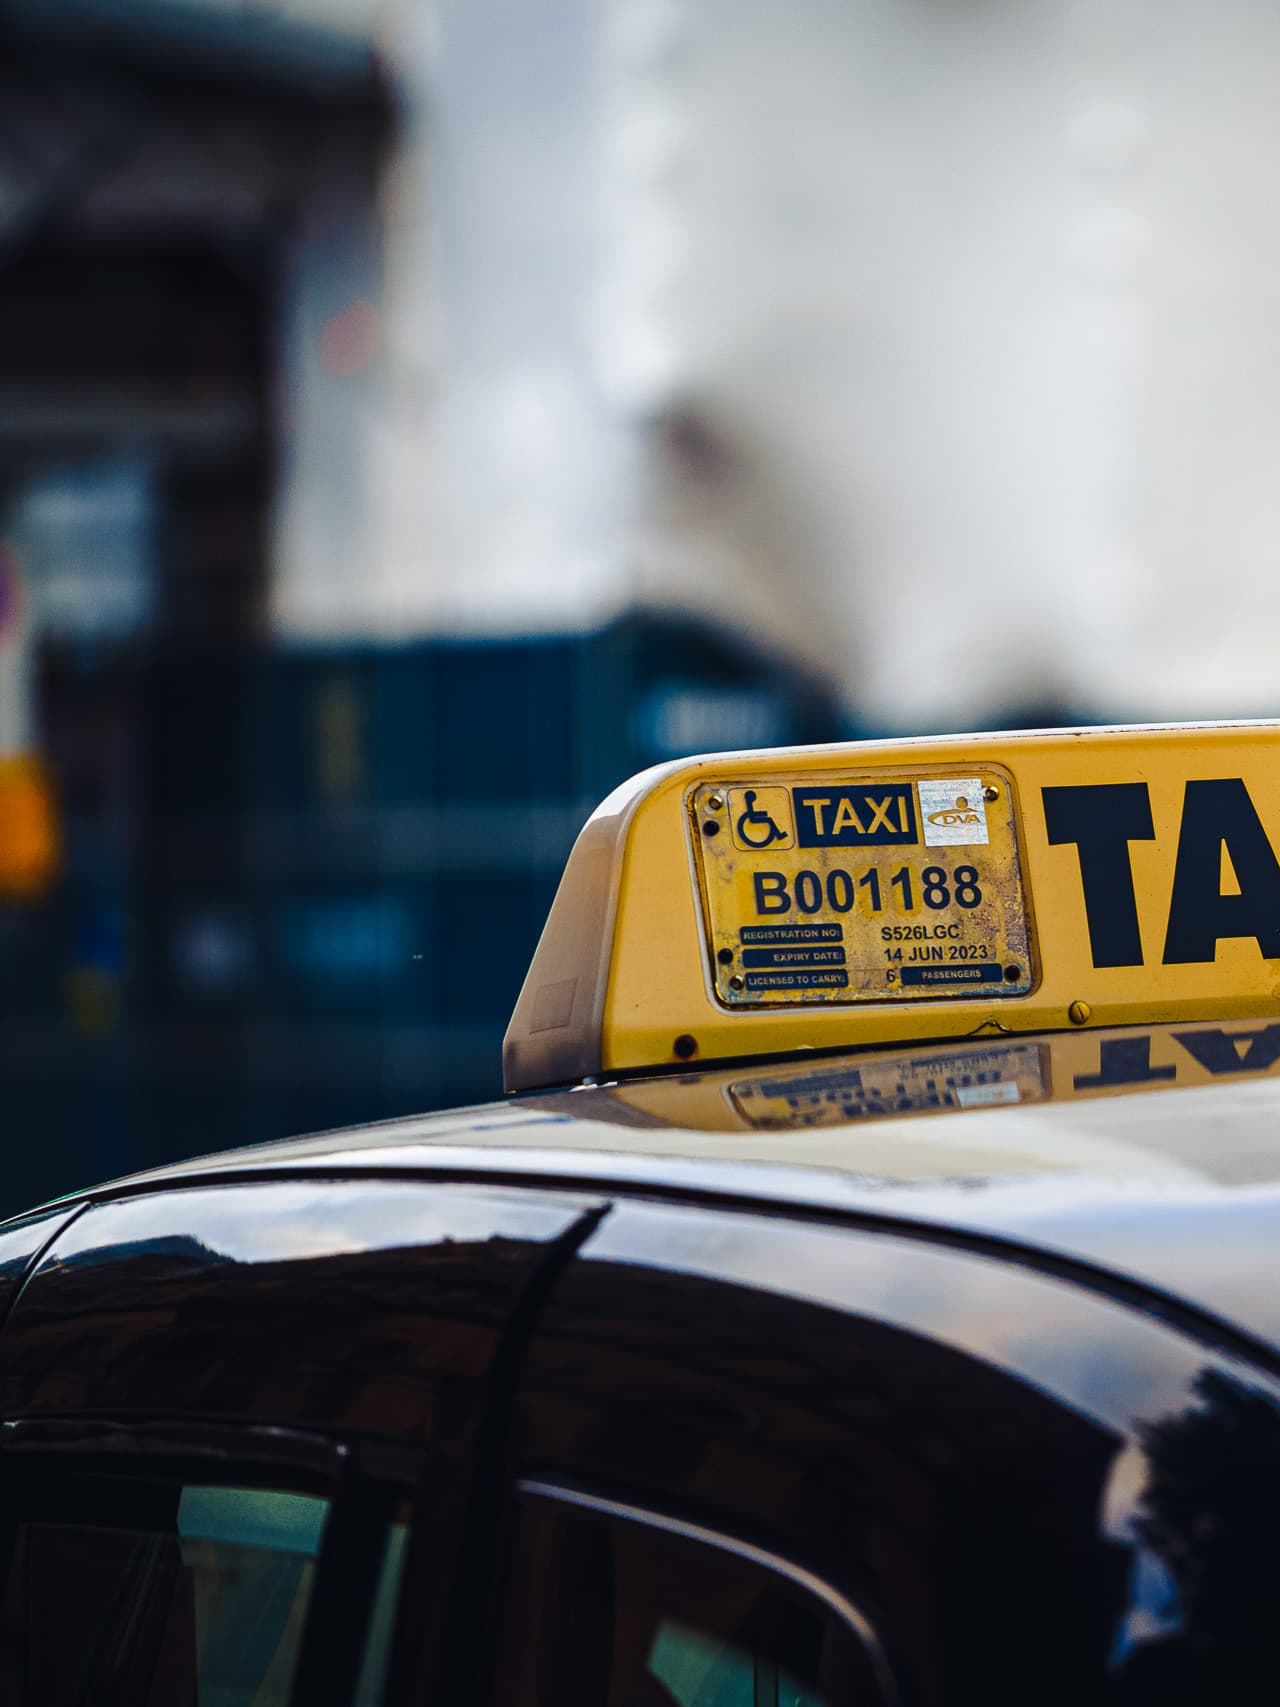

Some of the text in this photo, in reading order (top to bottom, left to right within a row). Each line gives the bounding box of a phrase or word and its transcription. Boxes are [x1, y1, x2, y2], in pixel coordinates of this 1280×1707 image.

[803, 796, 909, 835] TAXI
[943, 813, 981, 825] DVA
[754, 865, 982, 915] B001188
[743, 929, 818, 940] REGISTRATION
[881, 924, 960, 941] S526LGC
[773, 952, 810, 962] EXPIRY
[884, 947, 903, 961] 14
[909, 946, 943, 961] JUN
[949, 944, 988, 960] 2023
[748, 976, 794, 985] LICENSED
[797, 976, 809, 984] TO
[886, 969, 896, 983] 6
[921, 969, 982, 979] PASSENGERS
